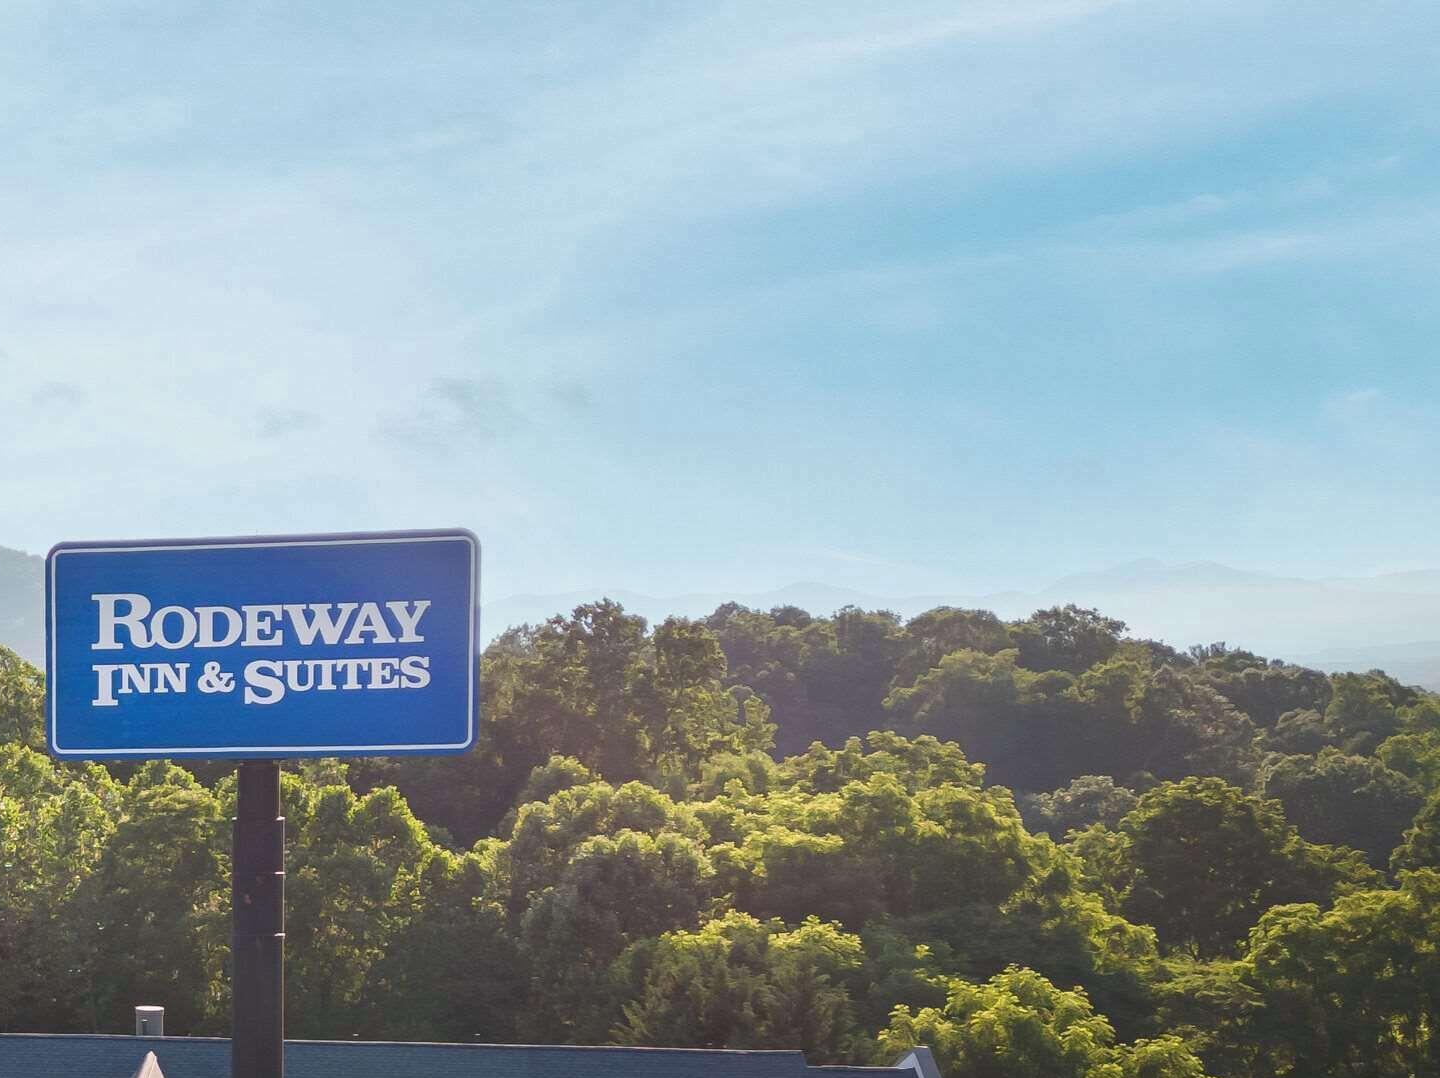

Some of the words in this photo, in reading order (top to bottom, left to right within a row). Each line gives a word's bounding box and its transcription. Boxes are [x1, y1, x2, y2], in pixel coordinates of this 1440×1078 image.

[91, 593, 431, 650] RODEWAY
[92, 663, 190, 706] INN
[197, 661, 236, 693] &
[244, 656, 431, 704] SUITES
